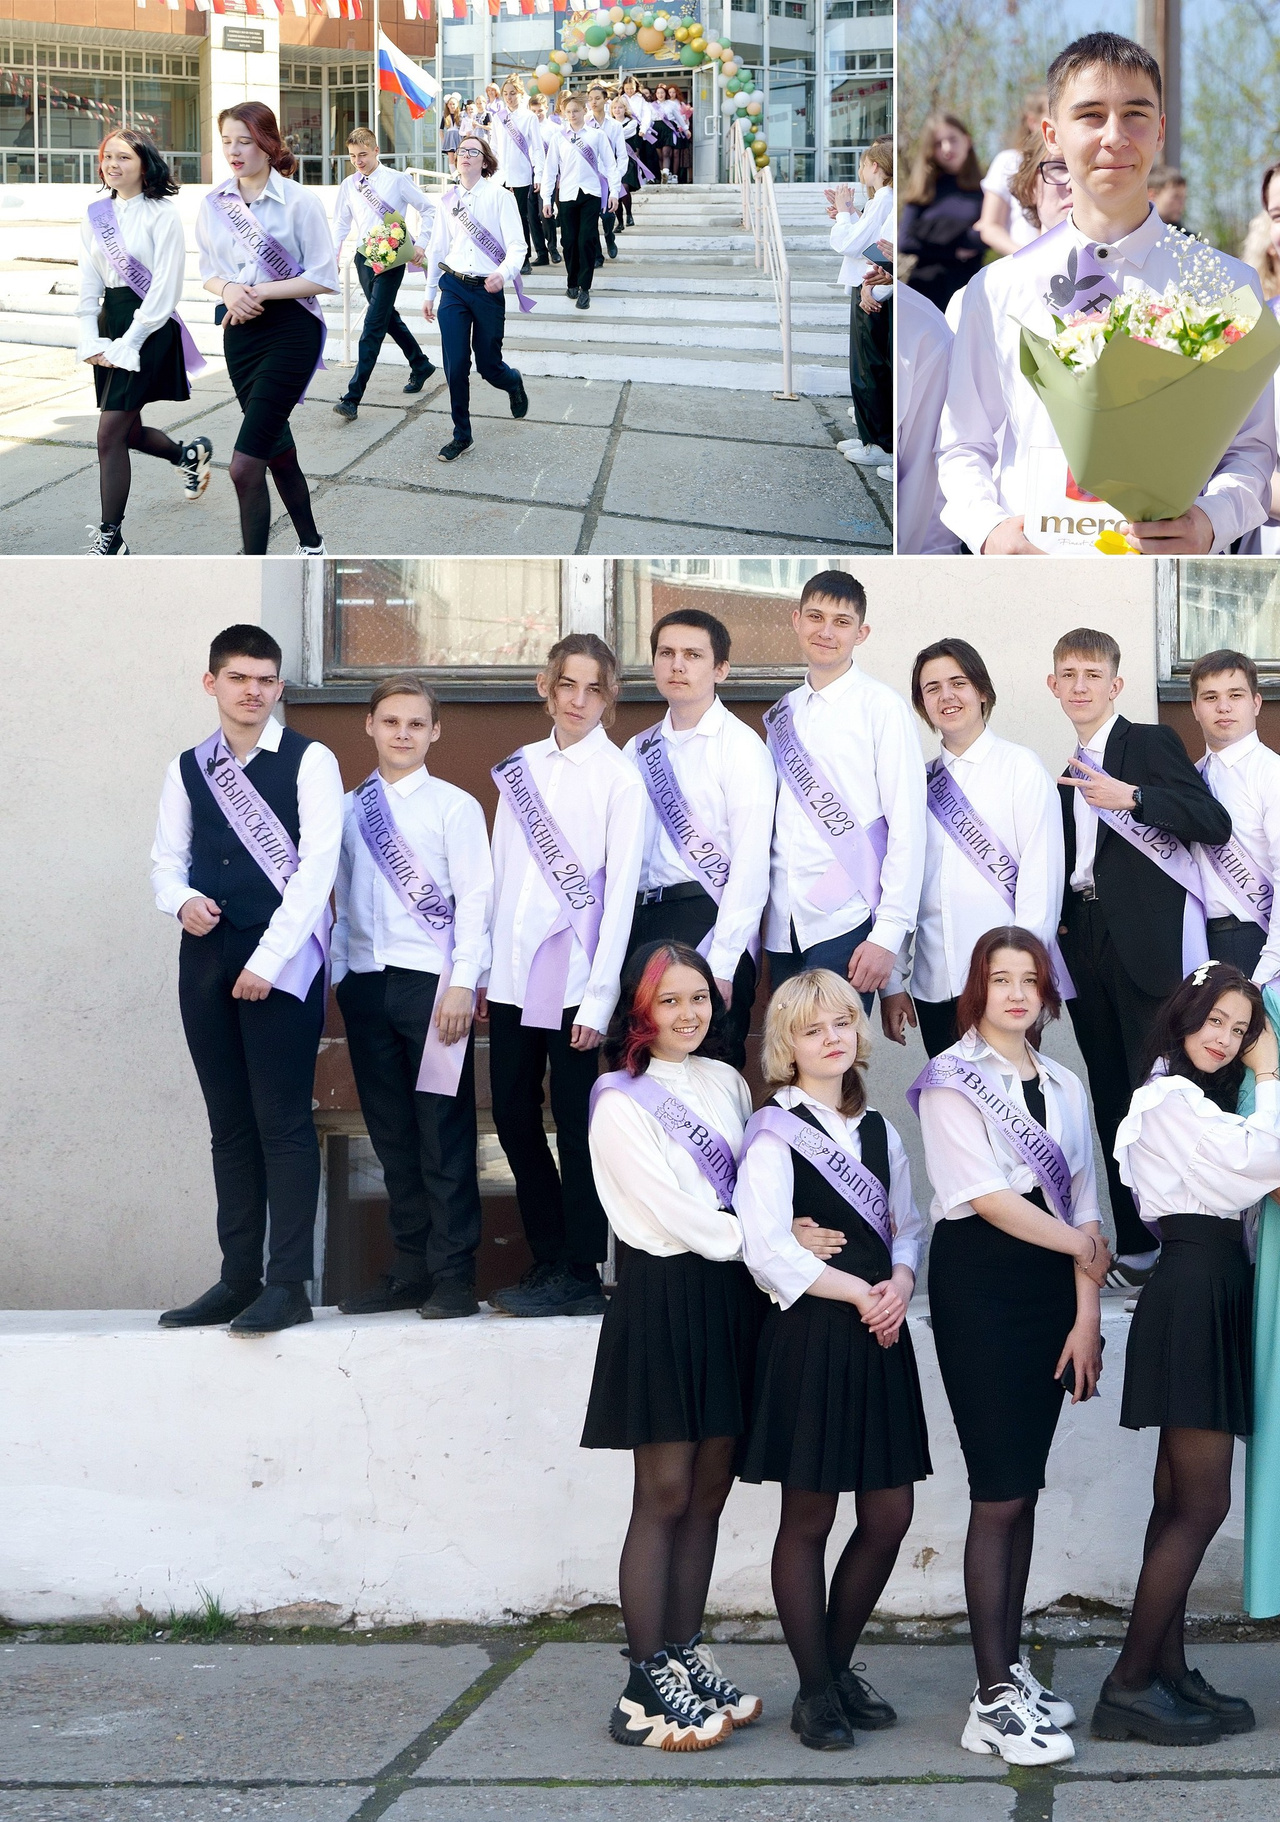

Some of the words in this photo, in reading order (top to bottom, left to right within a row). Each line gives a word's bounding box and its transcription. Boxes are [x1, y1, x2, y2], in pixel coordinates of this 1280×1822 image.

[228, 204, 293, 279] ВЫПУСКНИЦА
[459, 212, 500, 257] ВЫПУСКНИК
[214, 767, 293, 870] ВЫПУСКНИК
[645, 748, 700, 845] ВЫПУСКНИК
[774, 713, 820, 797] ВЫПУСКНИК
[809, 792, 855, 836] 2023
[361, 788, 419, 887] ВЫПУСКНИК
[408, 884, 454, 930] 2023
[504, 765, 564, 865] ВЫПУСКНИК
[552, 863, 595, 910] 2023
[930, 776, 996, 860] ВЫПУСКНИК
[987, 855, 1019, 900] 202
[962, 1072, 1066, 1192] ВЫПУСКНИЦА
[1038, 1129, 1055, 1149] КИРА
